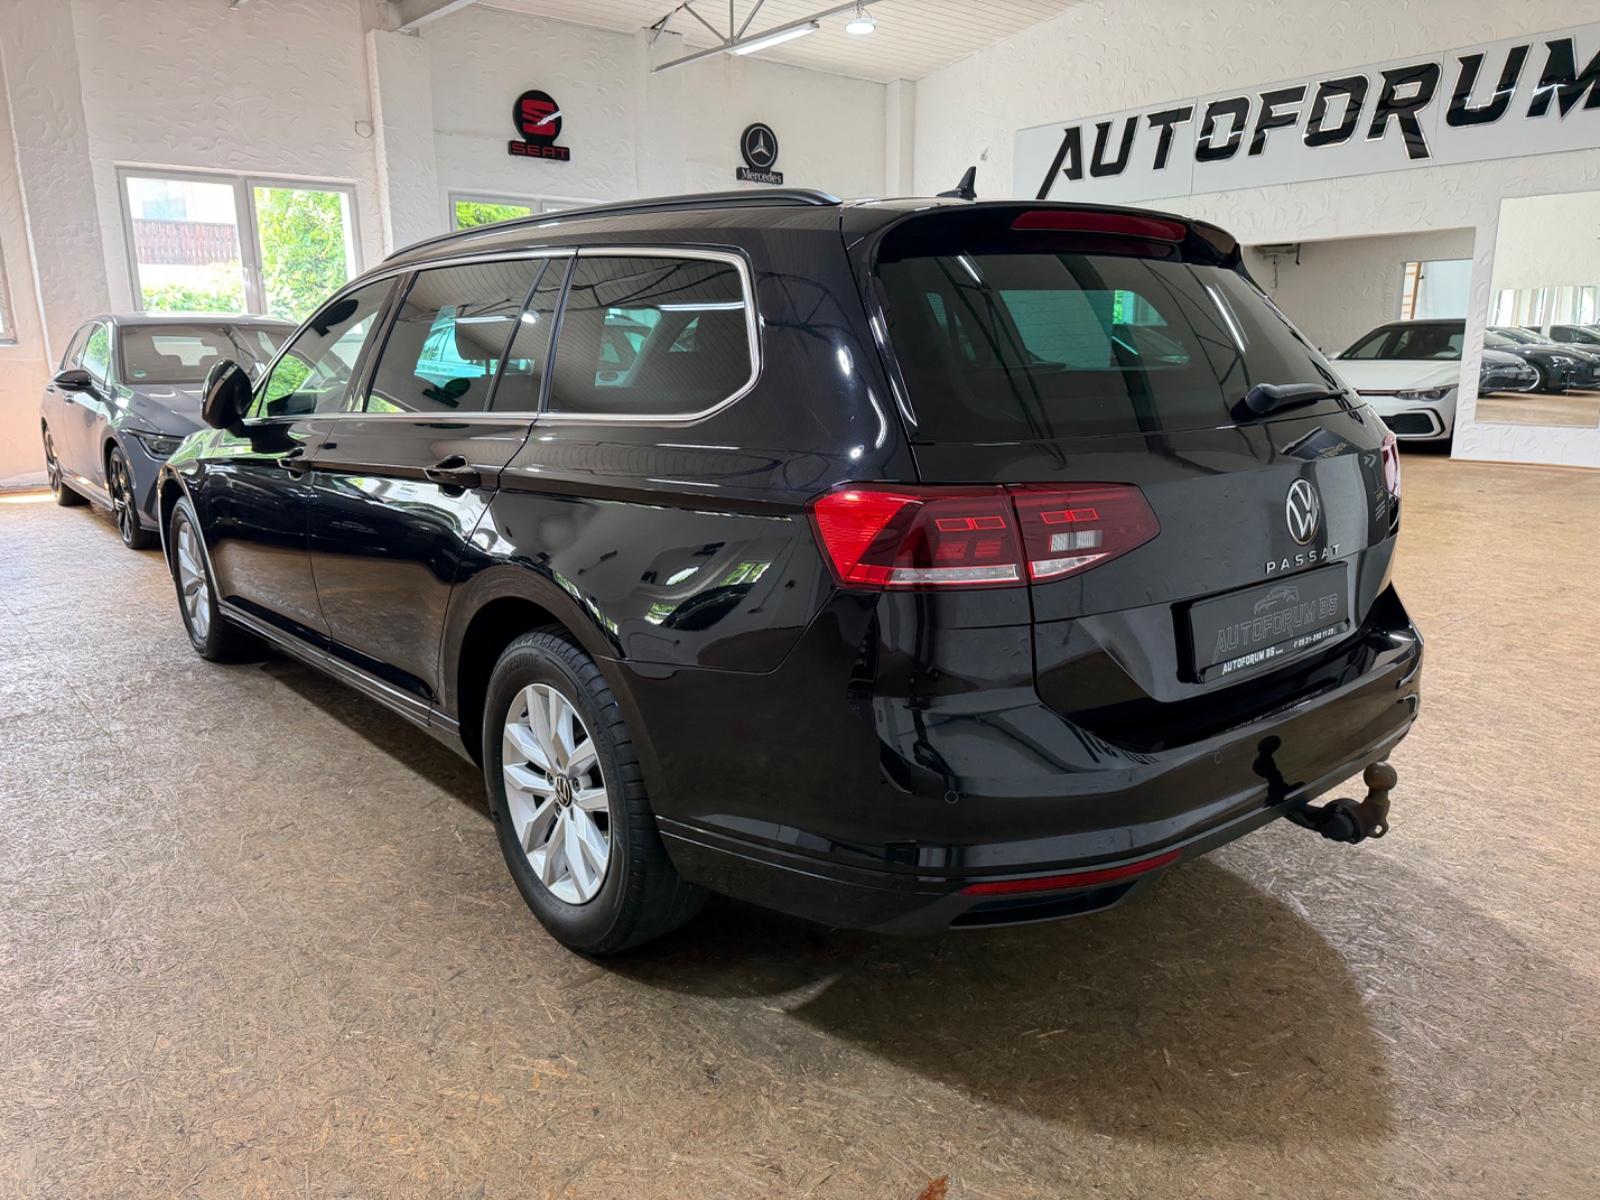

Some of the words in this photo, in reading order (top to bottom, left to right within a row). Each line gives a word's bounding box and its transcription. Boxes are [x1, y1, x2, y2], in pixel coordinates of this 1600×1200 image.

[1036, 36, 1600, 200] AUTOFORUM
[511, 143, 569, 160] SEAT
[741, 168, 782, 184] Mercedes
[1265, 544, 1340, 574] PASSAT
[1211, 600, 1315, 665] AUTOFORUM
[1318, 593, 1338, 620] BS
[1221, 650, 1264, 675] AUTOFORUM
[1265, 646, 1275, 659] BS
